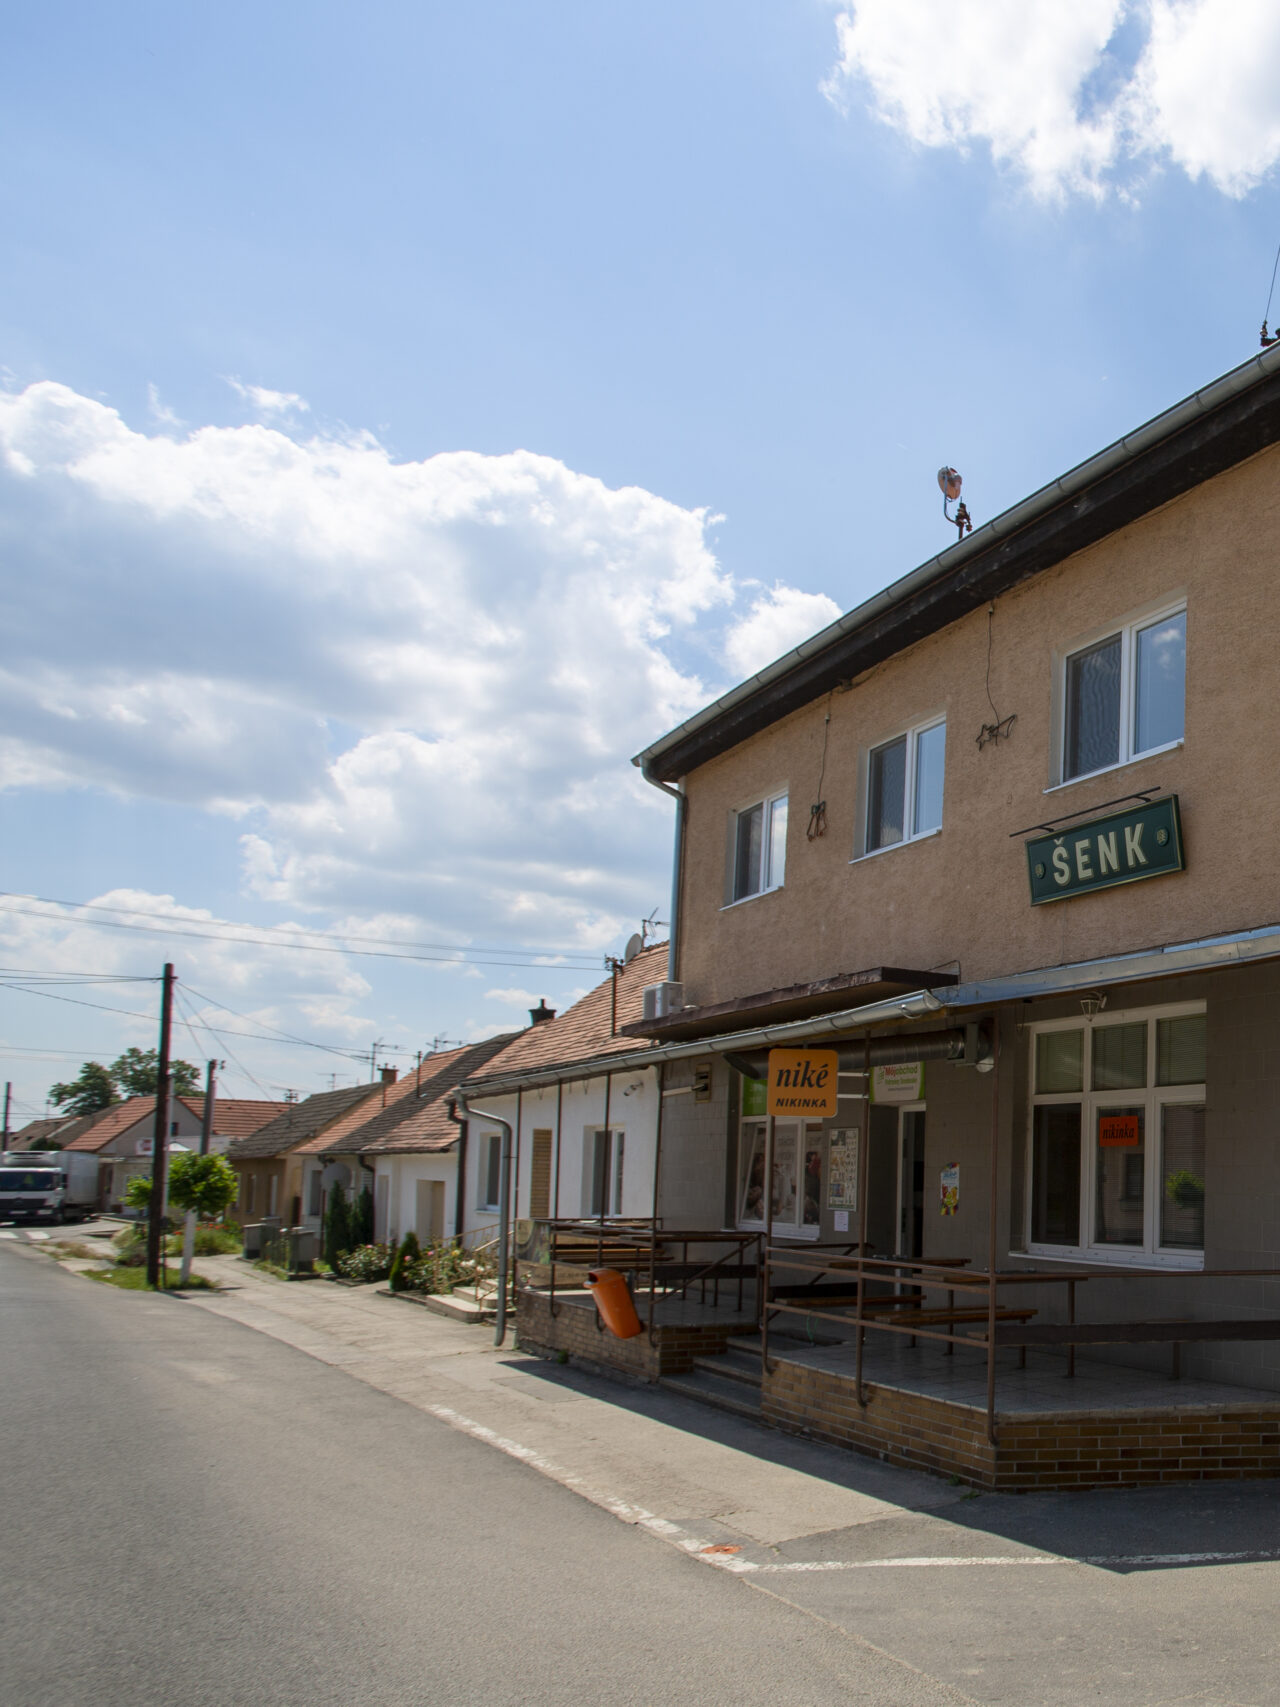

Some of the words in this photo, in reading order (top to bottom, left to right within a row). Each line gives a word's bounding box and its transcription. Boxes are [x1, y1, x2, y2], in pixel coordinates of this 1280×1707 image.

[1052, 822, 1148, 886] ŠENK
[776, 1060, 829, 1088] niké
[776, 1098, 827, 1108] NIKINKA
[1102, 1123, 1135, 1139] nikinka
